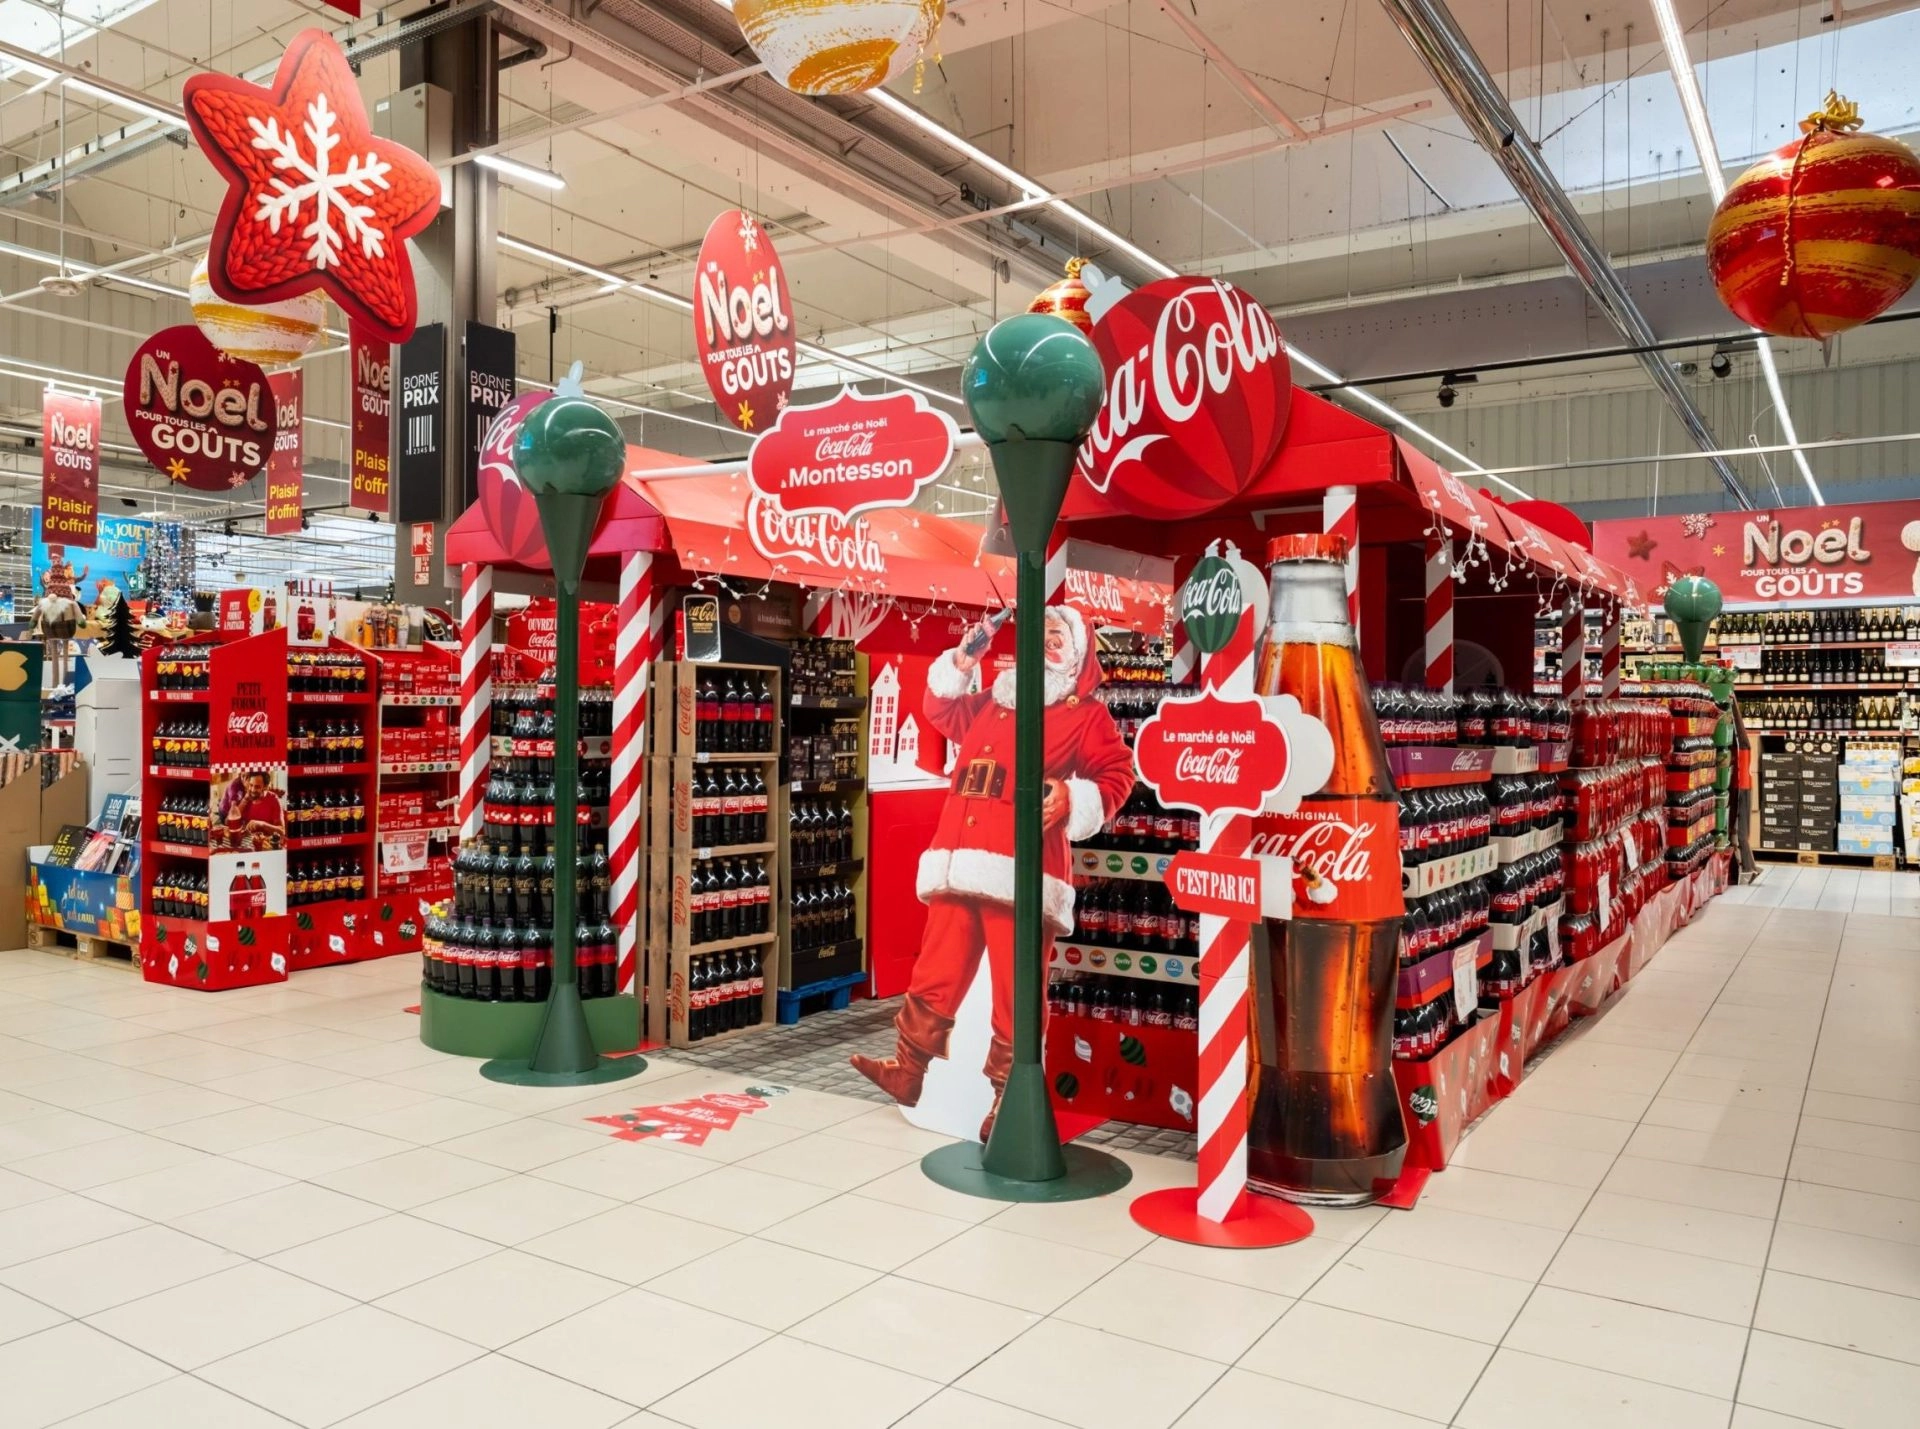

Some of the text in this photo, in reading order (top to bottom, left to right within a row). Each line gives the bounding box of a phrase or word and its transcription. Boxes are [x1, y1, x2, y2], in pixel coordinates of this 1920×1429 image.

[700, 265, 788, 345] Noël
[156, 350, 170, 360] UN
[707, 351, 725, 364] POUR
[726, 347, 743, 358] TOUS
[721, 345, 792, 395] GOÛTS
[404, 372, 439, 390] BORNE
[470, 371, 512, 392] BORNE
[140, 353, 268, 432] Noël
[404, 386, 439, 409] PRIX
[135, 410, 207, 432] POUR TOUS LES
[804, 417, 888, 437] Le marché de Noël
[51, 412, 94, 451] Noël
[151, 423, 261, 467] GOÛTS
[815, 431, 876, 461] Coca-Cola
[55, 451, 92, 471] GOÛTS
[789, 458, 912, 488] Montesson
[270, 483, 298, 500] Plaisir
[48, 496, 93, 515] Plaisir
[268, 505, 299, 520] d'offrir
[45, 517, 93, 534] d'offrir
[1756, 514, 1770, 523] UN
[1744, 516, 1871, 565] Noël
[1741, 567, 1806, 577] POUR TOUS LES
[1755, 567, 1864, 597] GOÛTS
[228, 711, 269, 734] Coca-Cola
[1163, 729, 1256, 745] Le marché de Noël
[304, 766, 324, 774] NOUVEAU
[1175, 747, 1243, 785] Coca-Cola
[58, 833, 71, 845] LE
[53, 845, 76, 857] BEST
[1177, 867, 1255, 905] C'EST PAR ICI
